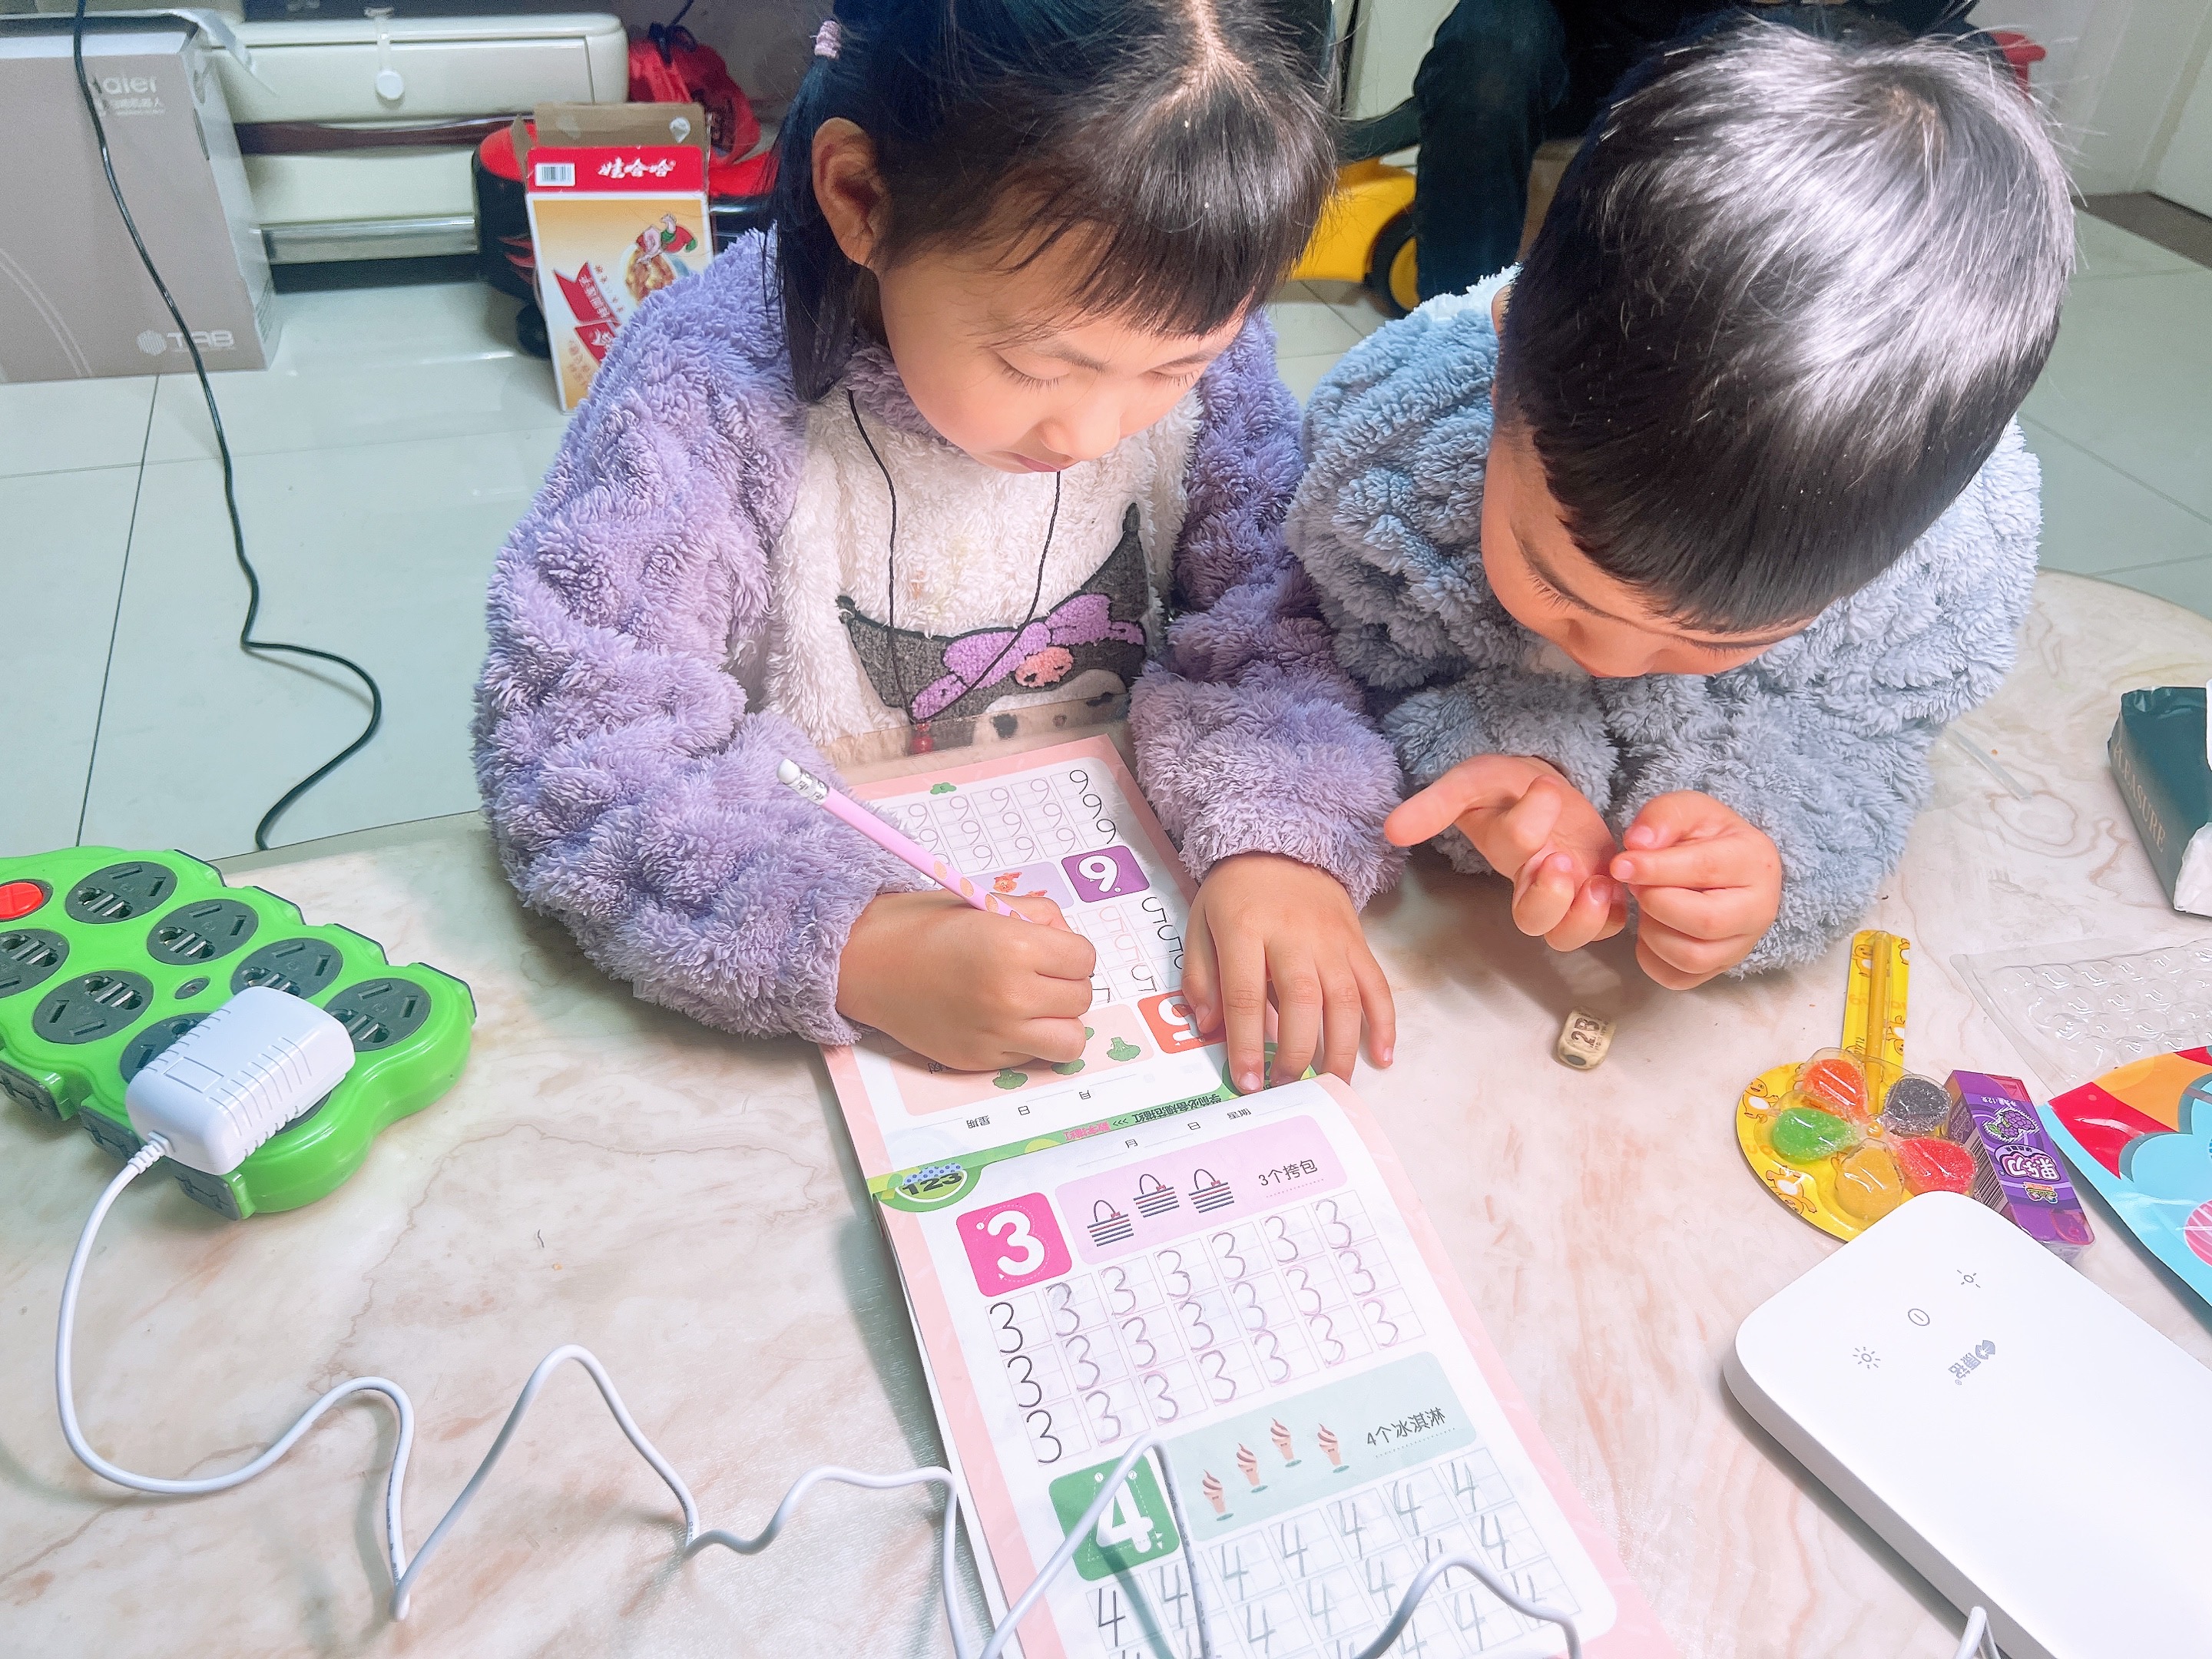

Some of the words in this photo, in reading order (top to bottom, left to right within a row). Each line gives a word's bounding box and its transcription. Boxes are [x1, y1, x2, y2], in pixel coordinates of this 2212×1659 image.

[94, 75, 157, 94] aier
[598, 156, 671, 179] 娃哈哈
[1018, 1105, 1031, 1116] 日
[1079, 1091, 1091, 1101] 月
[1131, 1094, 1223, 1124] 学前必备规范描红
[966, 1114, 991, 1129] 星期
[1124, 1138, 1138, 1149] 月
[1187, 1121, 1201, 1131] 日
[1227, 1108, 1252, 1121] 星期
[902, 1171, 962, 1195] 123
[1258, 1159, 1318, 1186] 3个挎包
[987, 1210, 1045, 1277] 3
[990, 1302, 1023, 1353] 3
[1046, 1282, 1080, 1336] 3
[1101, 1267, 1137, 1316] 3
[1157, 1250, 1191, 1298] 3
[1212, 1232, 1246, 1280] 3
[1264, 1216, 1298, 1263] 3
[1316, 1198, 1352, 1250] 3
[1007, 1355, 1042, 1408] 3
[1065, 1335, 1101, 1391] 3
[1121, 1316, 1157, 1369] 3
[1178, 1295, 1214, 1351] 3
[1233, 1281, 1267, 1332] 3
[1286, 1266, 1321, 1316] 3
[1339, 1248, 1376, 1296] 3
[1026, 1409, 1062, 1463] 3
[1085, 1389, 1121, 1444] 3
[1144, 1369, 1179, 1422] 3
[1199, 1349, 1237, 1403] 3
[1254, 1329, 1291, 1384] 3
[1310, 1313, 1345, 1366] 3
[1363, 1298, 1398, 1347] 3
[1366, 1406, 1446, 1446] 4个冰淇淋
[1095, 1476, 1154, 1554] 4
[1098, 1588, 1126, 1647] 4
[1160, 1564, 1189, 1629] 4
[1220, 1542, 1250, 1601] 4
[1280, 1522, 1308, 1577] 4
[1338, 1500, 1367, 1560] 4
[1392, 1479, 1424, 1536] 4
[1451, 1461, 1480, 1512] 4
[1245, 1603, 1277, 1654] 4
[1306, 1579, 1337, 1637] 4
[1365, 1558, 1396, 1616] 4
[1480, 1514, 1511, 1569] 4
[1454, 1591, 1486, 1651] 4
